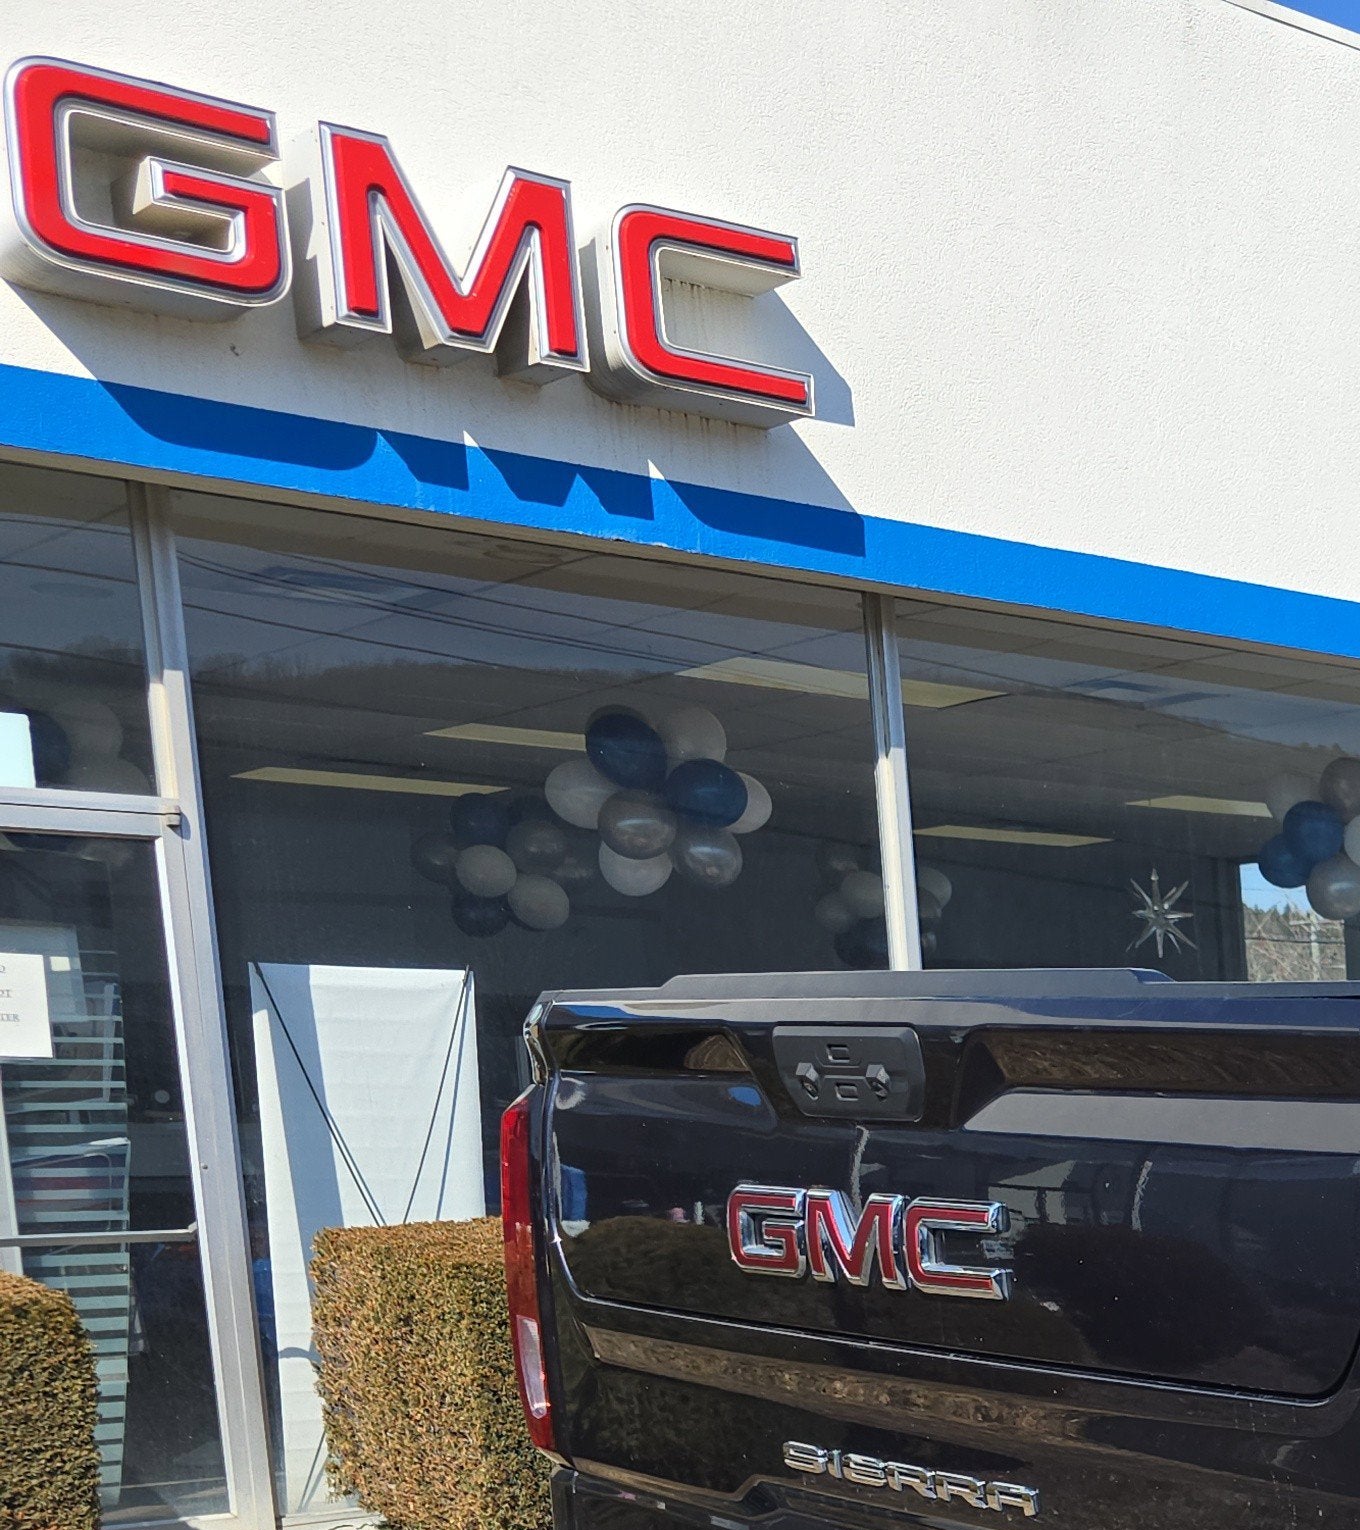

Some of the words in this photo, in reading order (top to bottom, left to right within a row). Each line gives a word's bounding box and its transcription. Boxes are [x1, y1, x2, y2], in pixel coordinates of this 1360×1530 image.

[3, 55, 816, 422] GMC
[727, 1184, 1013, 1300] GMC
[783, 1440, 1040, 1517] SIERRA
